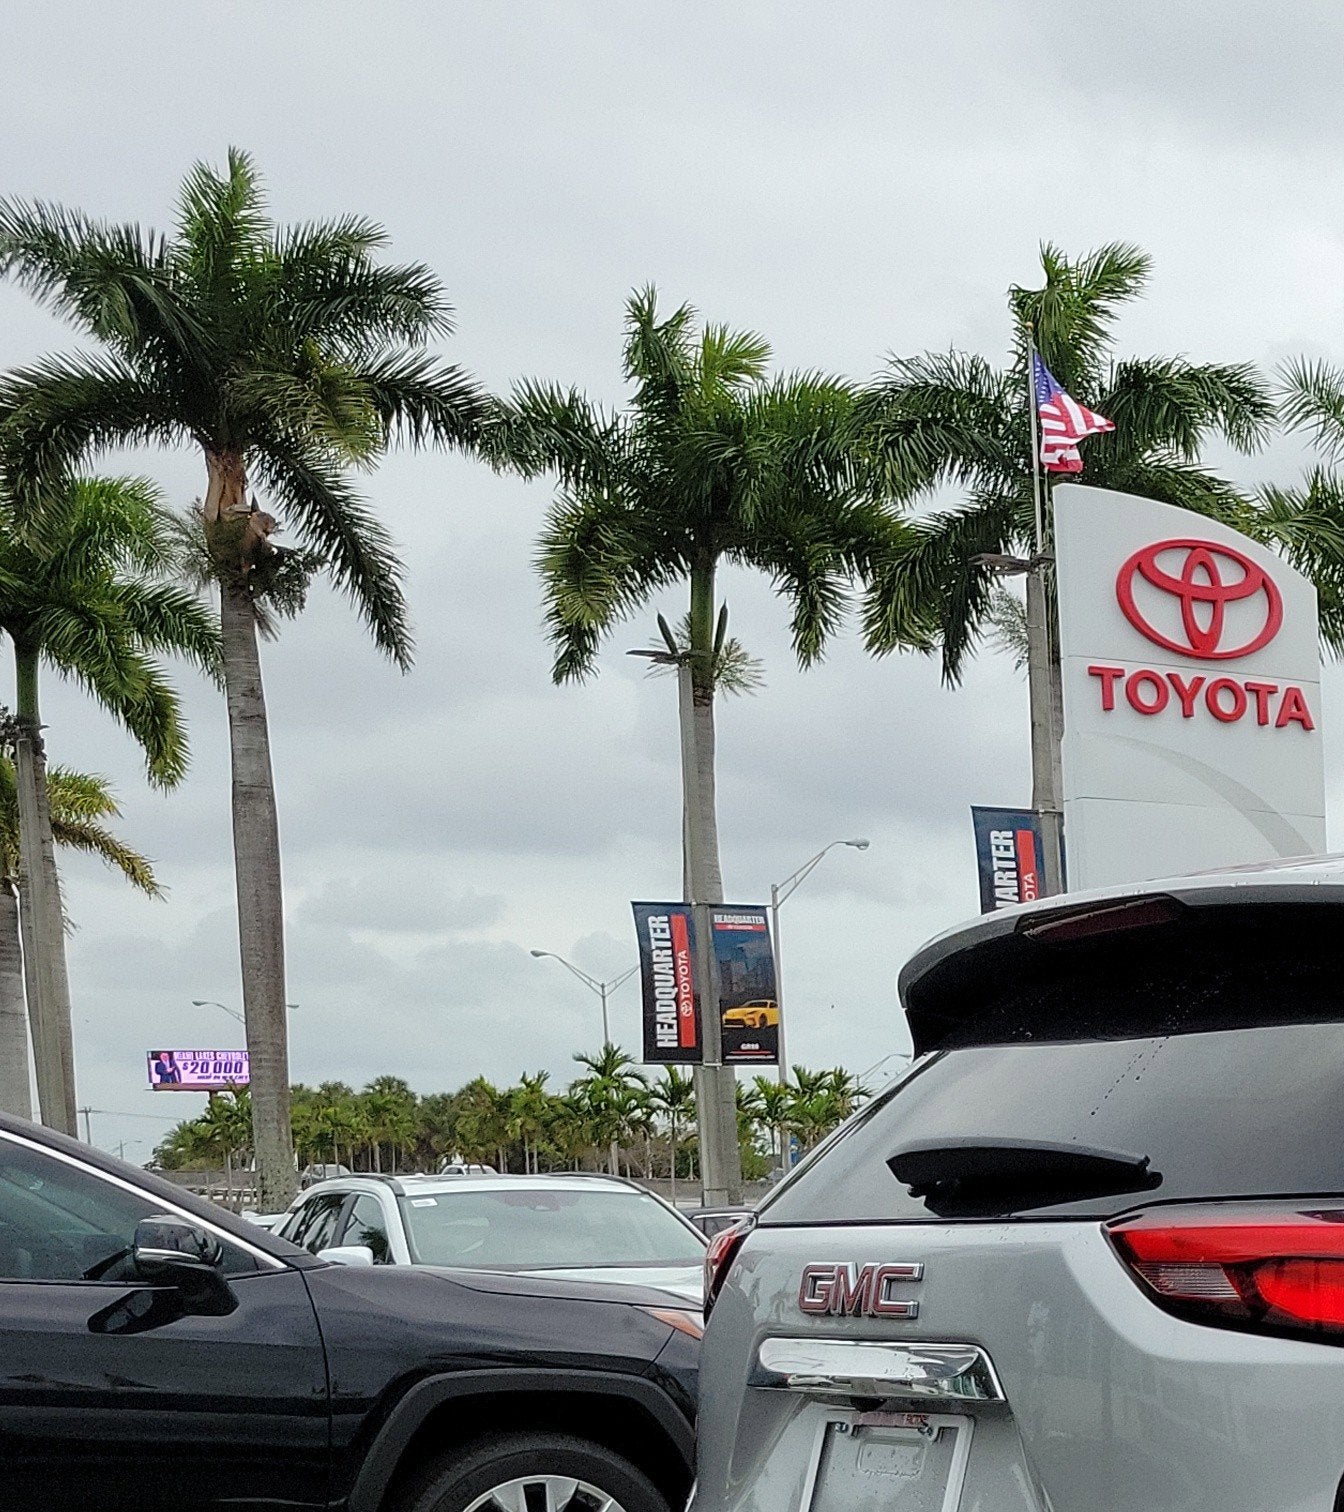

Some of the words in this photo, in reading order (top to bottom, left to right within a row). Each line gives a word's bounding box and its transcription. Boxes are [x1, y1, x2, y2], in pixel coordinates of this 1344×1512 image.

[1087, 665, 1315, 731] TOYOTA
[648, 915, 679, 1048] HEADQUARTER
[678, 949, 692, 1003] TOYOTA
[798, 1261, 925, 1319] GMC
